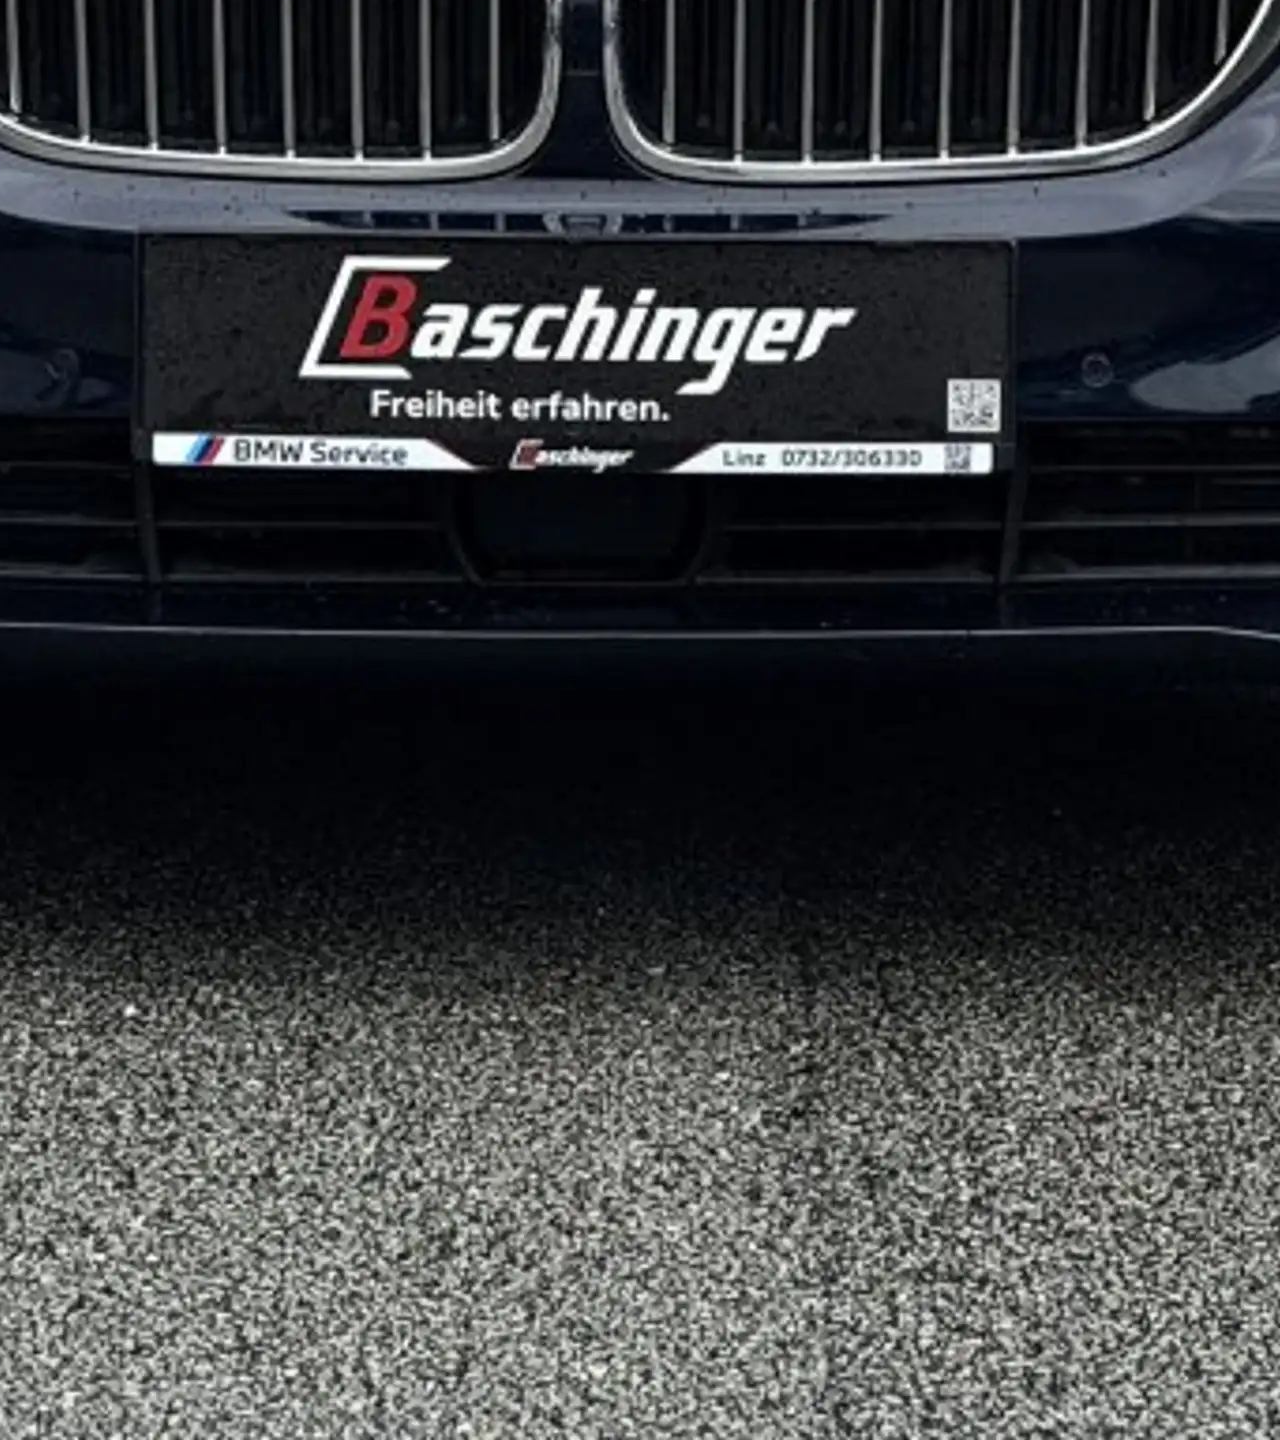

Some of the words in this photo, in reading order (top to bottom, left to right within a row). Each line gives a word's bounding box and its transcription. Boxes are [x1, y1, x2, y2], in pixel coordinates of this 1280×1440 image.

[339, 271, 857, 395] Baschinger
[371, 389, 502, 420] Freiheit
[511, 391, 671, 422] erfahren.
[234, 439, 304, 463] BMW
[309, 440, 408, 465] Service
[722, 450, 767, 467] Linz
